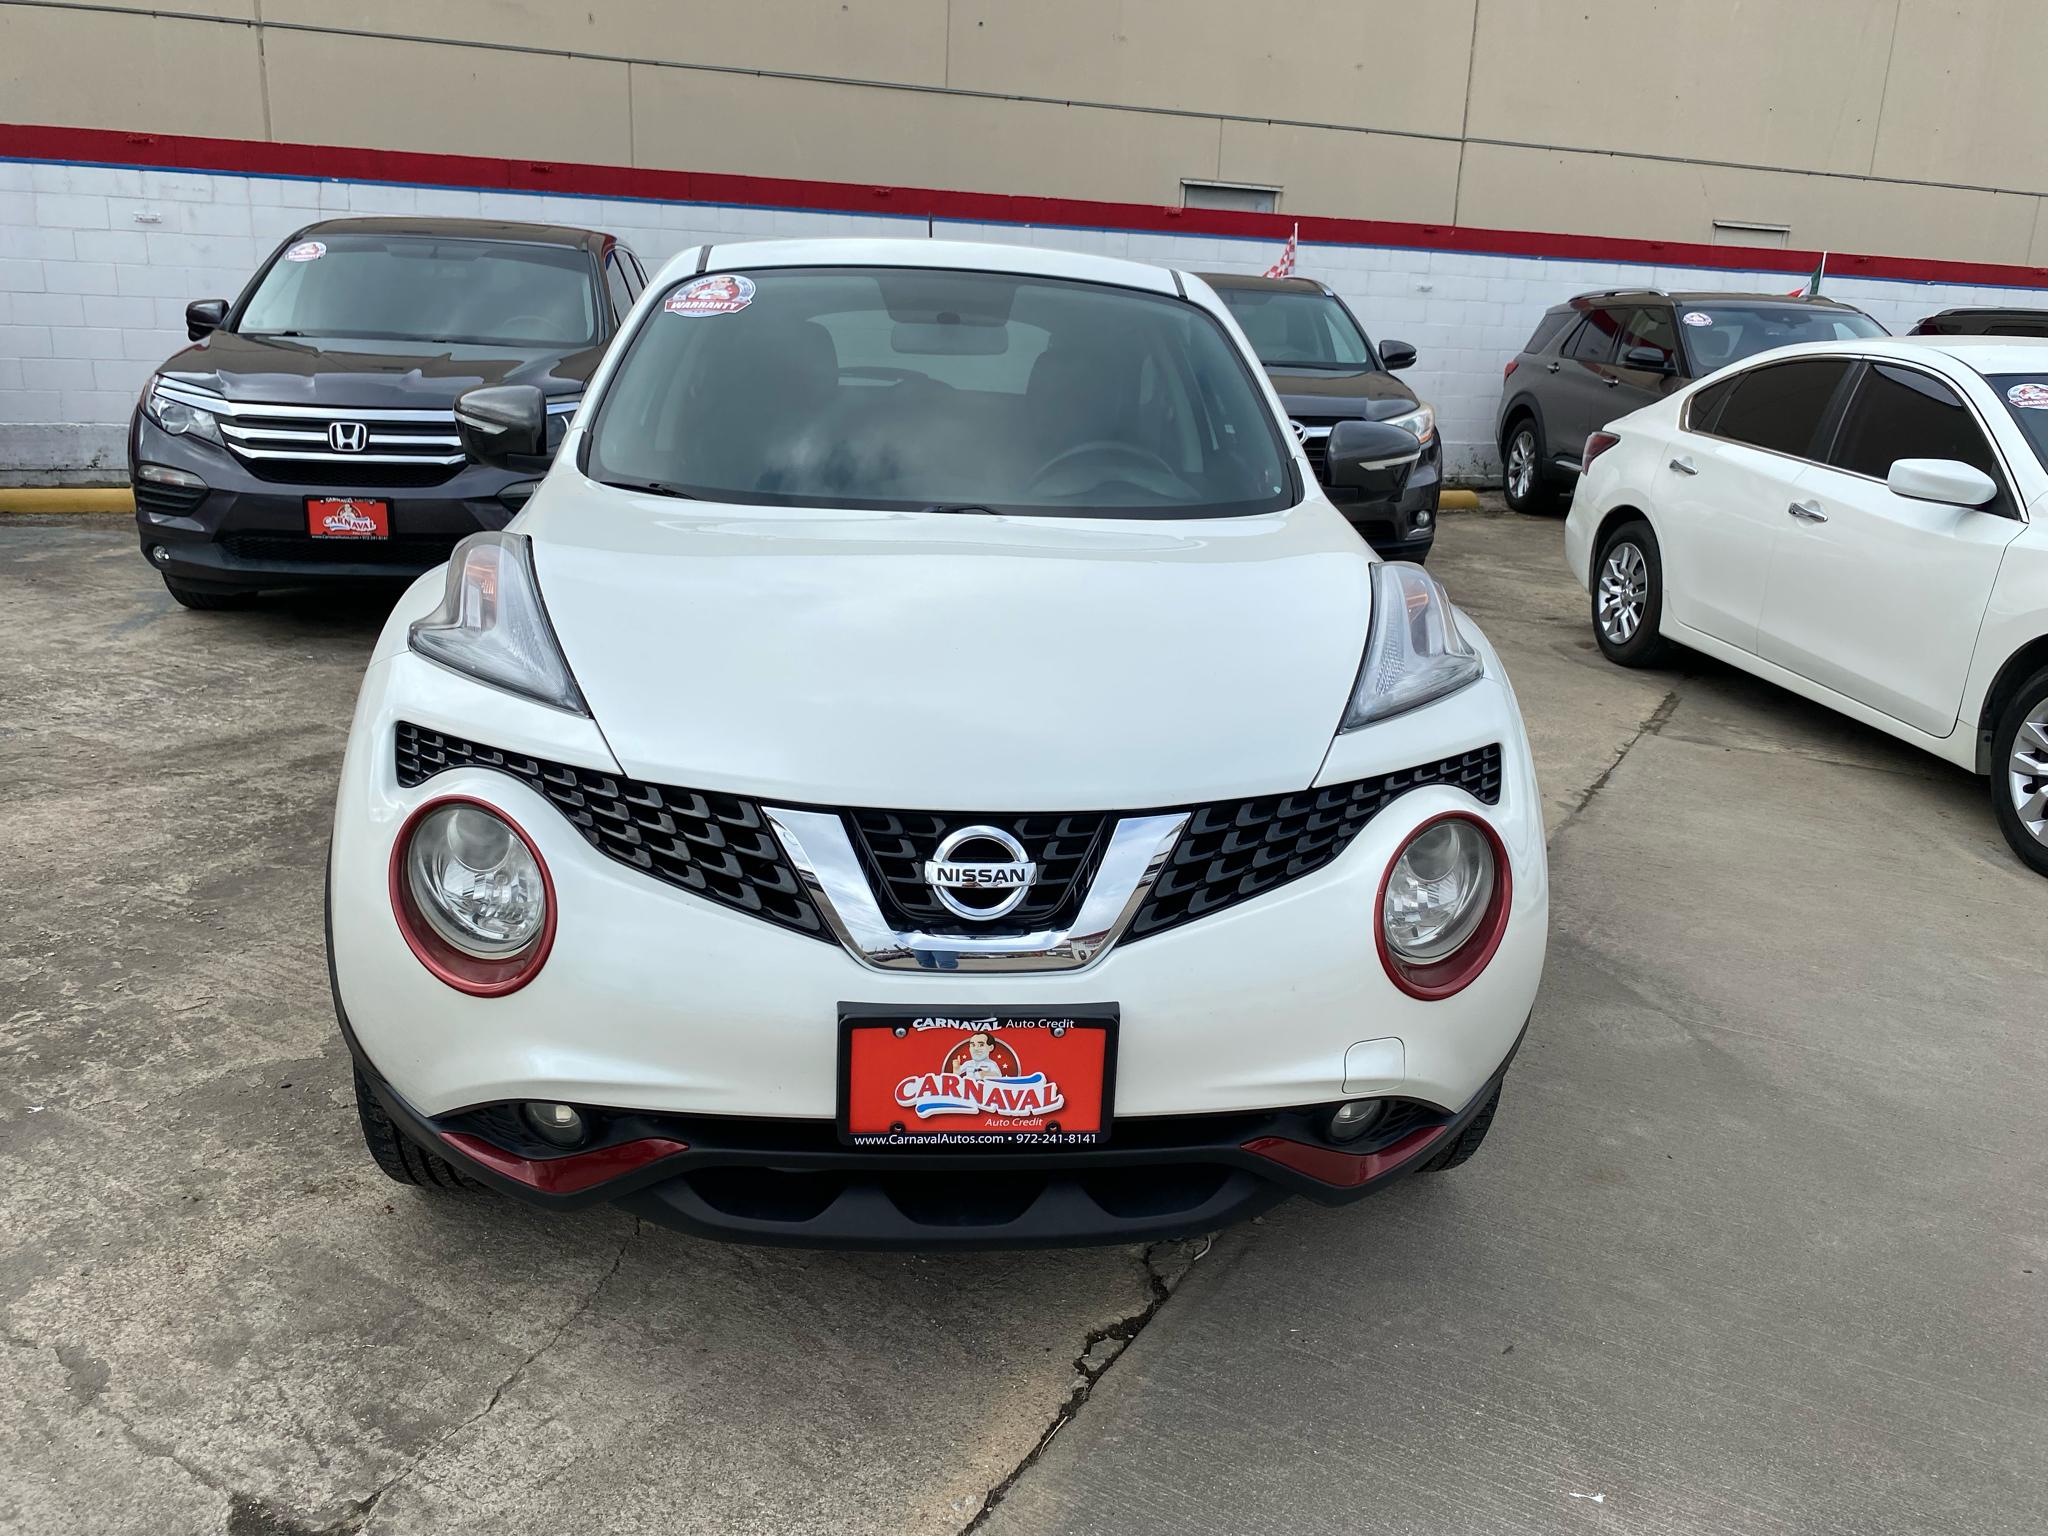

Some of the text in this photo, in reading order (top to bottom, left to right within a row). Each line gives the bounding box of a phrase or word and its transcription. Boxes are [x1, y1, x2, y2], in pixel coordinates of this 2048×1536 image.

[671, 301, 740, 310] WARRANTY
[323, 516, 377, 531] CARNAVAL
[937, 867, 1025, 883] NISSAN
[912, 1017, 1075, 1032] CARNAVAL Auto Credit
[896, 1073, 1063, 1115] CARNAVAL
[985, 1117, 1043, 1128] Auto Credit
[854, 1133, 1097, 1145] www.CarnavalAutos.com 972-241-8141
